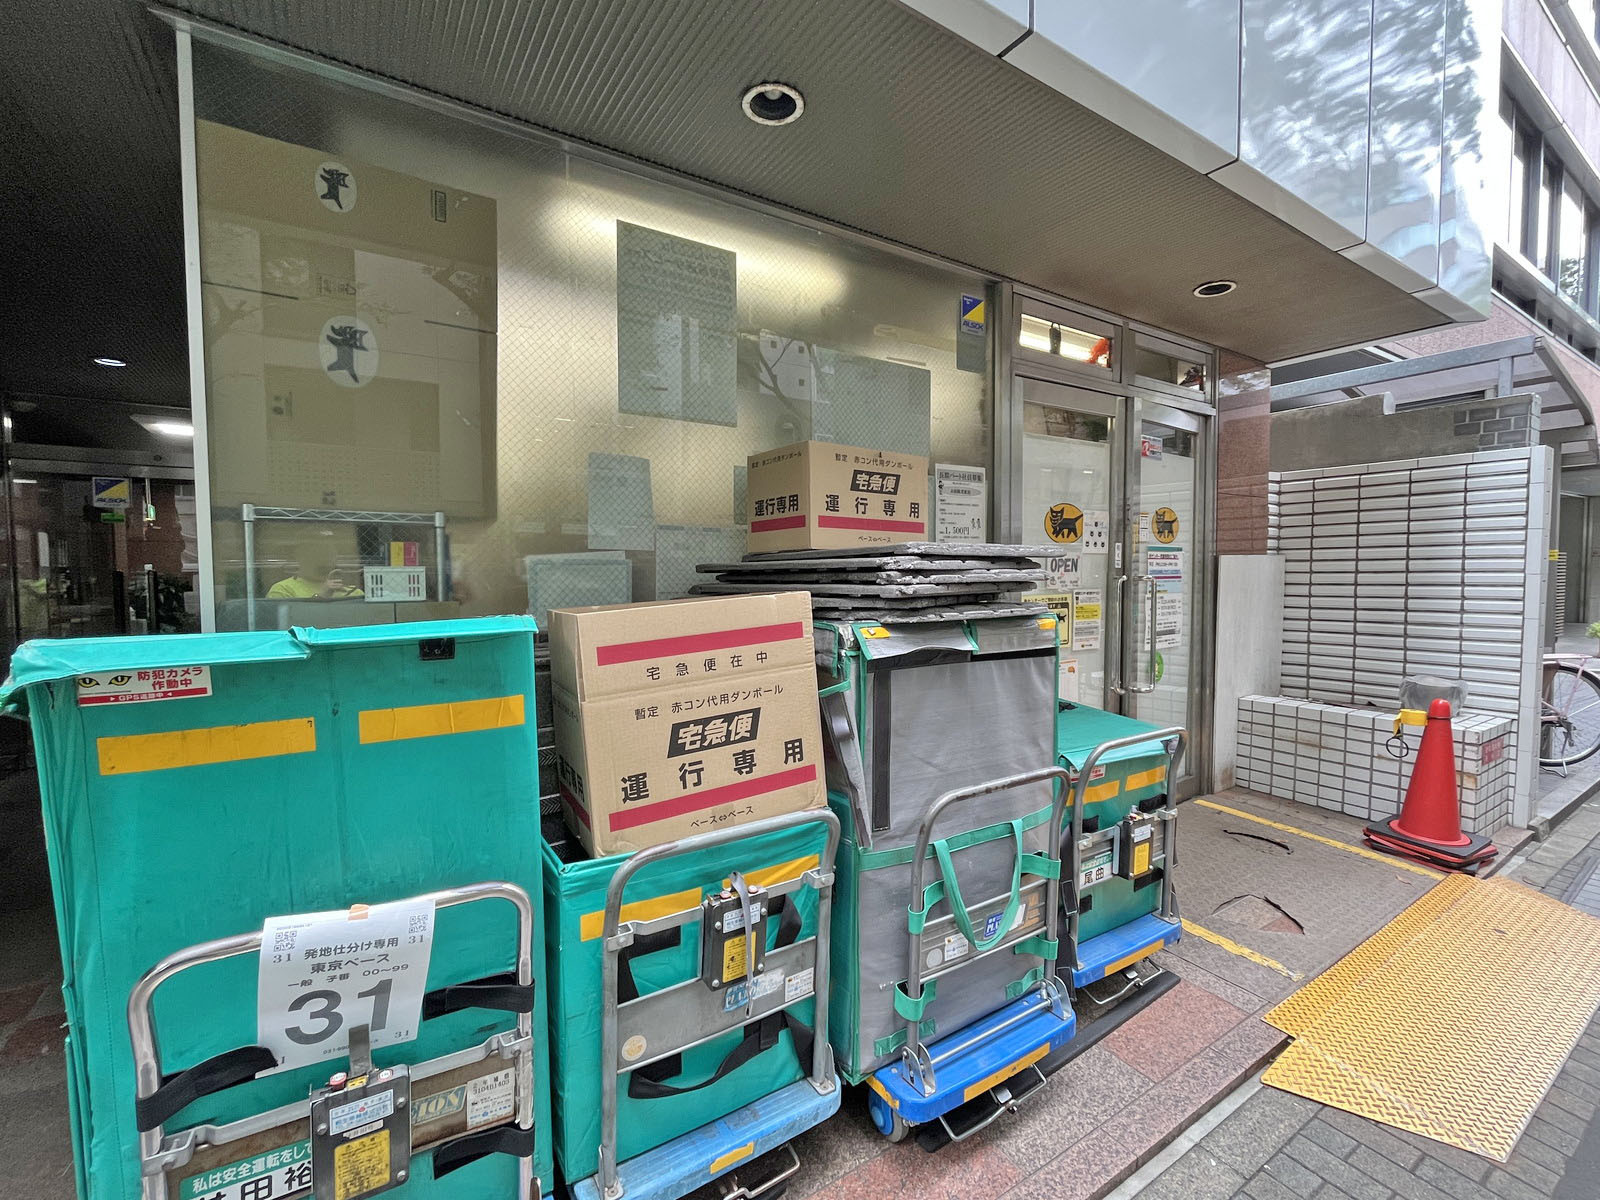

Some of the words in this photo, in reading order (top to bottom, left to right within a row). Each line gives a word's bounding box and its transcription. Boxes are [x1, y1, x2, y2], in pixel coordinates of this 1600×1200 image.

[855, 473, 897, 493] 宅急便
[754, 493, 800, 517] 運行専用
[825, 494, 920, 519] 運行専用
[1050, 558, 1079, 573] OPEN
[137, 666, 203, 681] 防犯カメラ
[646, 650, 768, 681] 宅急便在中
[151, 678, 193, 691] 作動中
[634, 705, 660, 721] 暫定
[671, 684, 784, 714] 赤コン代用ダンボール
[677, 712, 754, 751] 宅急便
[620, 737, 806, 805] 運行専用
[304, 937, 399, 960] 発地仕分け専用
[408, 934, 426, 945] 31
[272, 953, 294, 964] 31
[310, 953, 391, 974] 東京ベース
[284, 978, 393, 1046] 31
[394, 1029, 410, 1040] 31
